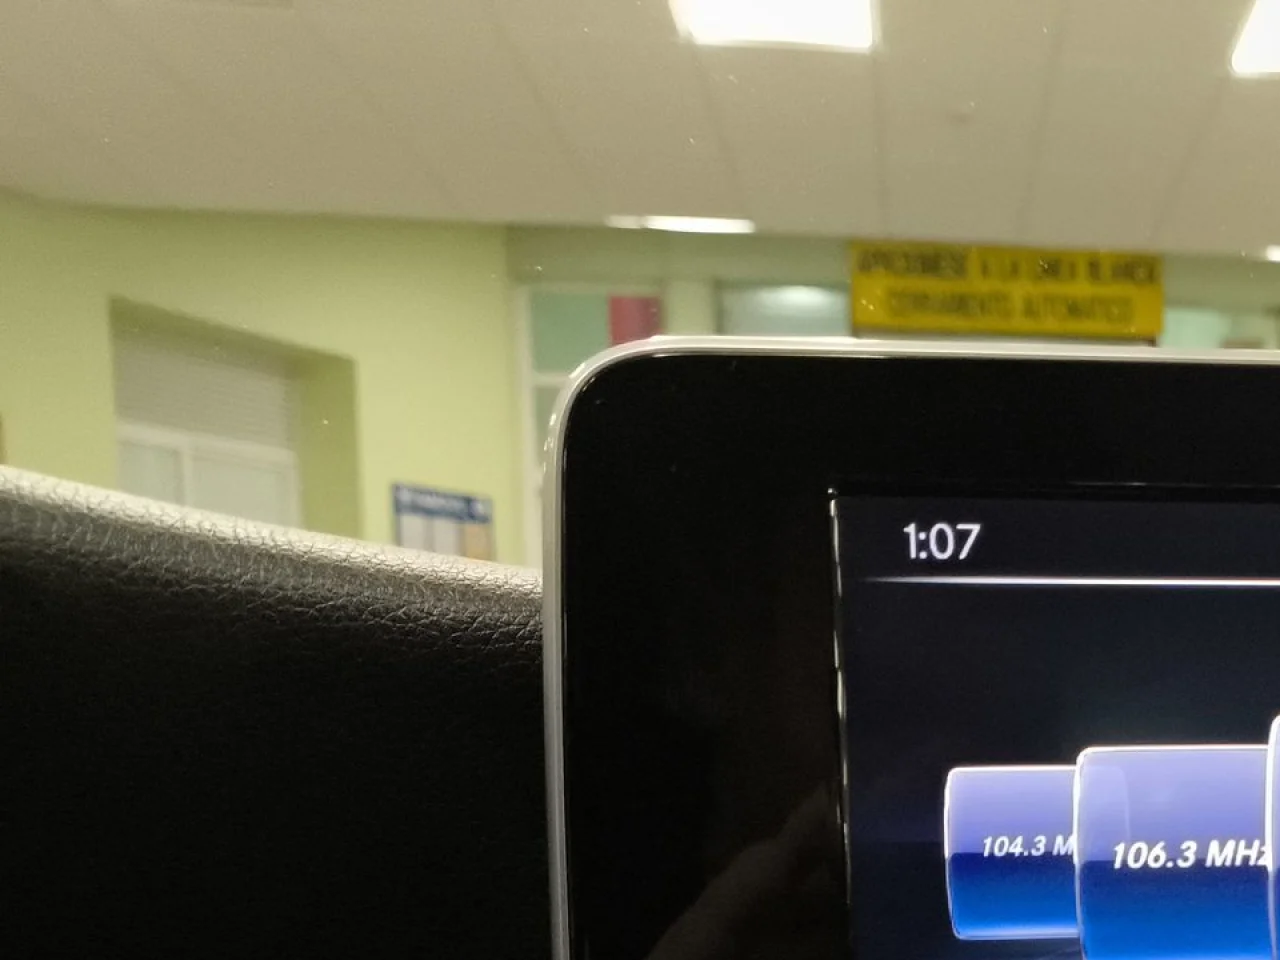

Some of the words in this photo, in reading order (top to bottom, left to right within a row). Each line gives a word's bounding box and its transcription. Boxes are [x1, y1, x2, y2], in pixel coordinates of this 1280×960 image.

[903, 522, 981, 560] 1:07
[983, 835, 1047, 858] 104.3
[1113, 840, 1198, 869] 106.3
